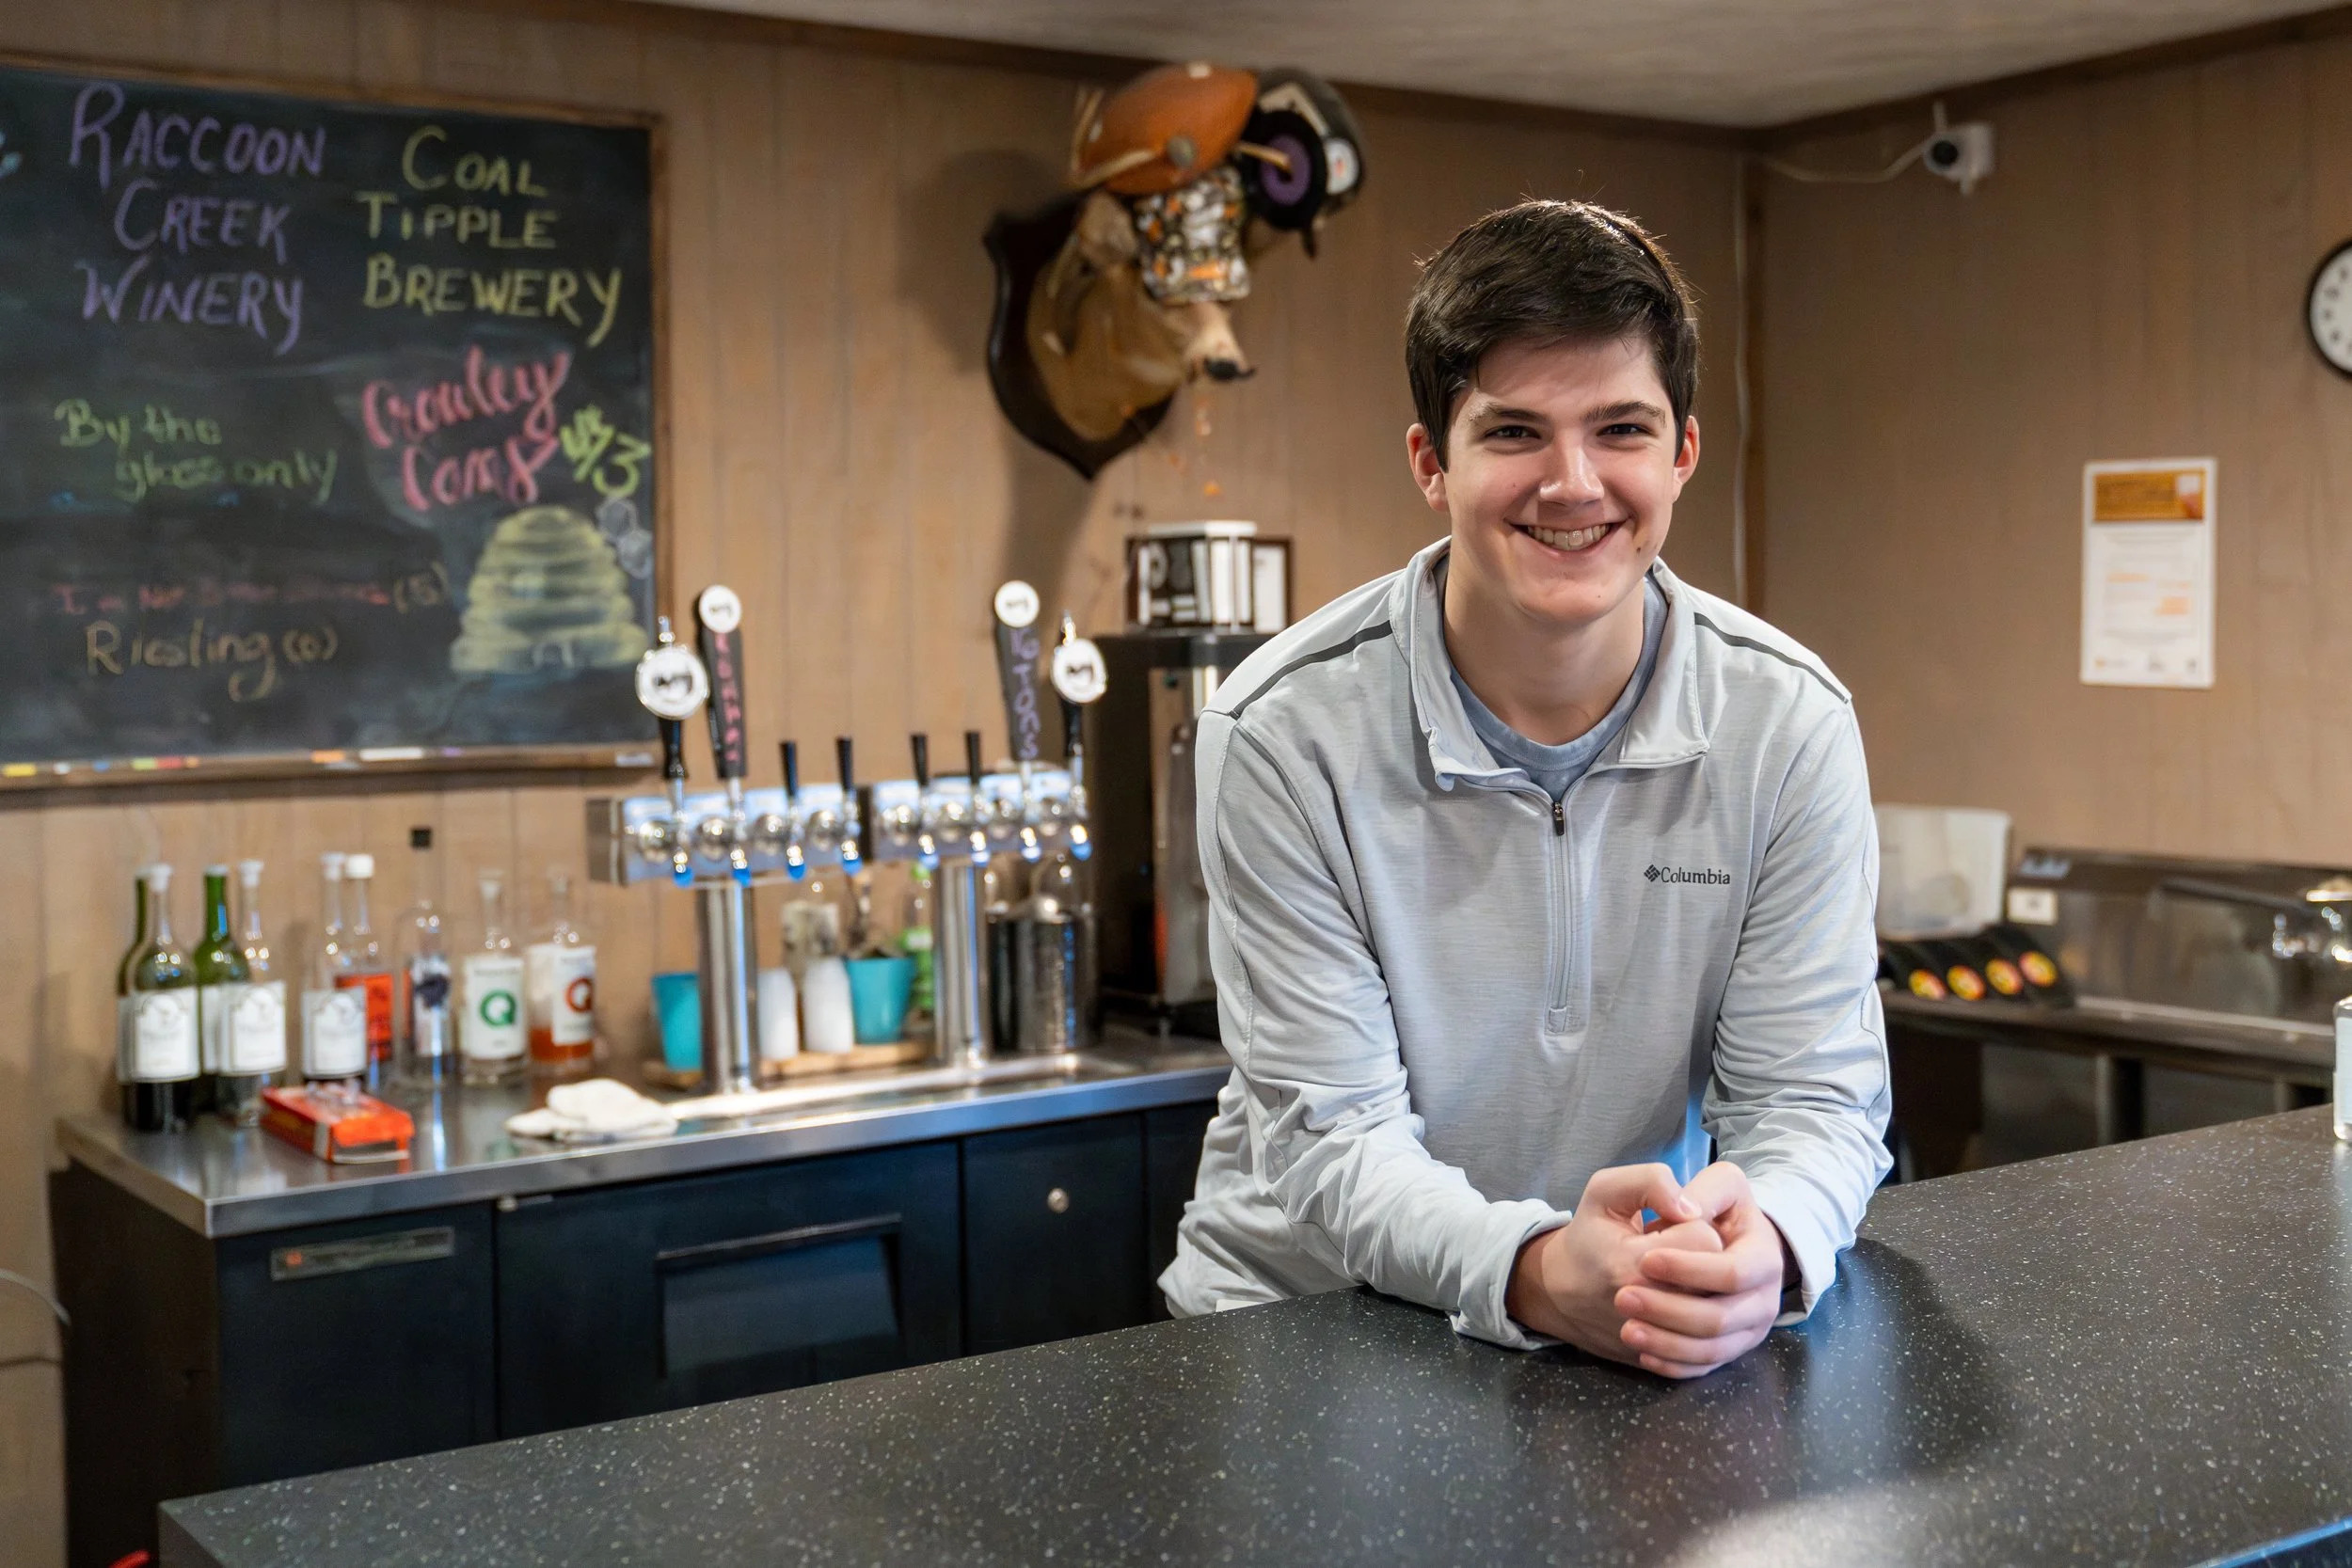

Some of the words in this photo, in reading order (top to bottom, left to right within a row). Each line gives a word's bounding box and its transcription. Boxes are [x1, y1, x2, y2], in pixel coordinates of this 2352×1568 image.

[70, 82, 325, 186] RACCOON
[402, 125, 548, 198] COAL
[115, 179, 292, 264] CREEK
[75, 256, 304, 356] WINERY
[363, 253, 621, 348] BREWERY
[54, 398, 130, 454] By
[142, 402, 222, 446] the
[233, 448, 338, 506] only
[1661, 866, 1731, 885] Columbia
[479, 988, 517, 1029] Q
